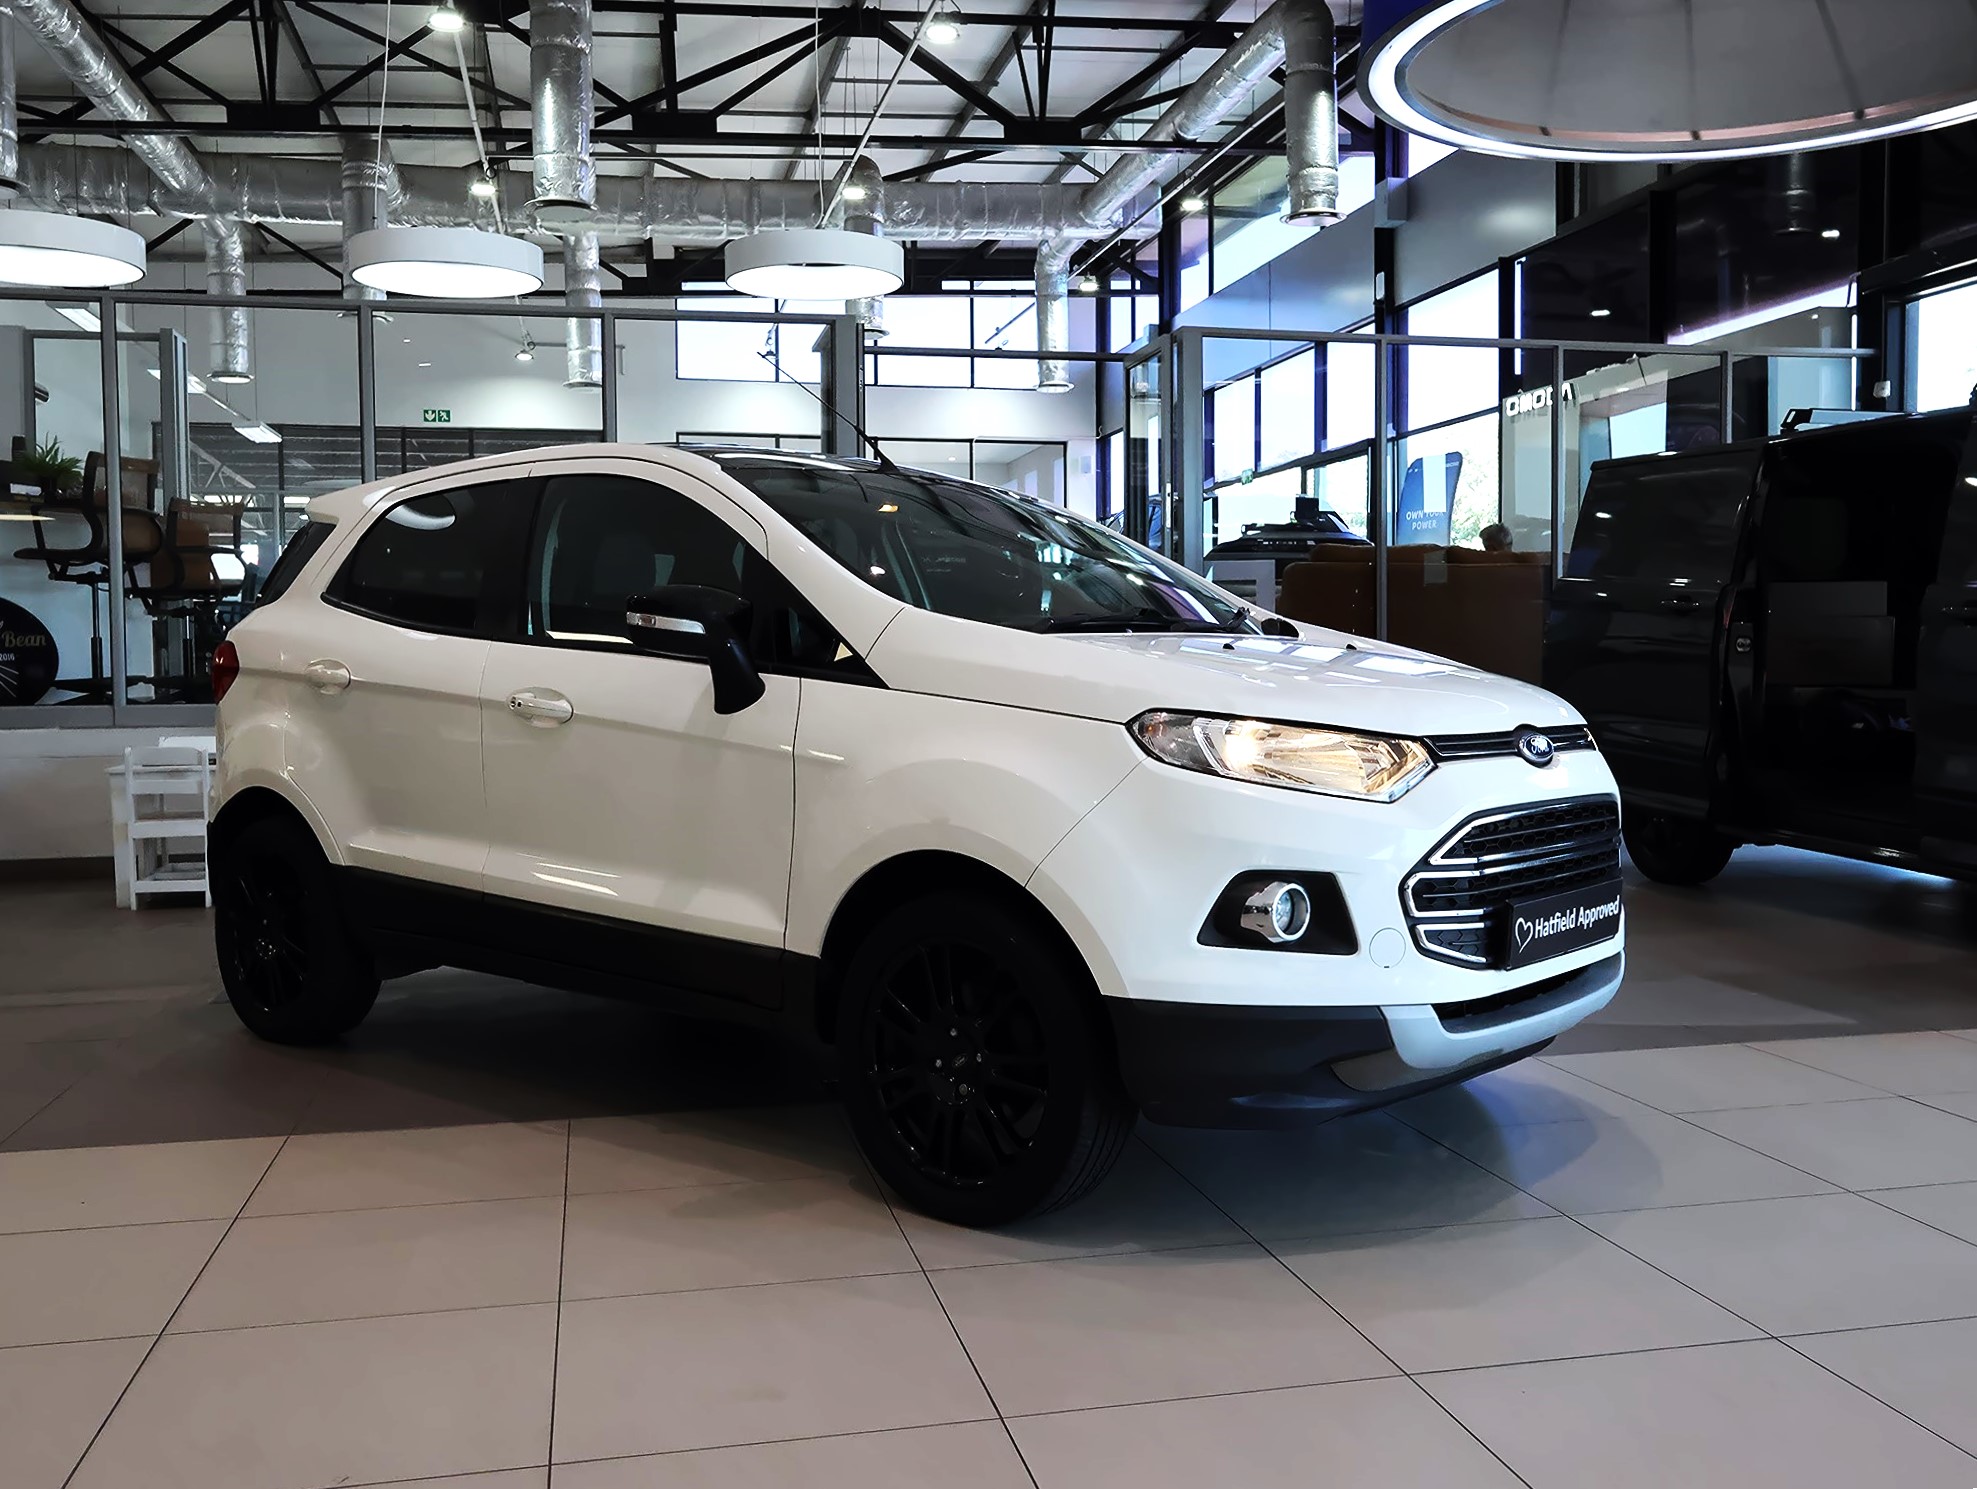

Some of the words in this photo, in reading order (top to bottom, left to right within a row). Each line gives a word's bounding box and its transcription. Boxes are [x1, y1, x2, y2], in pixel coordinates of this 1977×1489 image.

[1406, 510, 1423, 520] OWN
[1412, 519, 1437, 530] POWER
[1, 630, 47, 648] Bean
[1534, 907, 1576, 939] Hatfield
[1577, 894, 1620, 930] Approved
